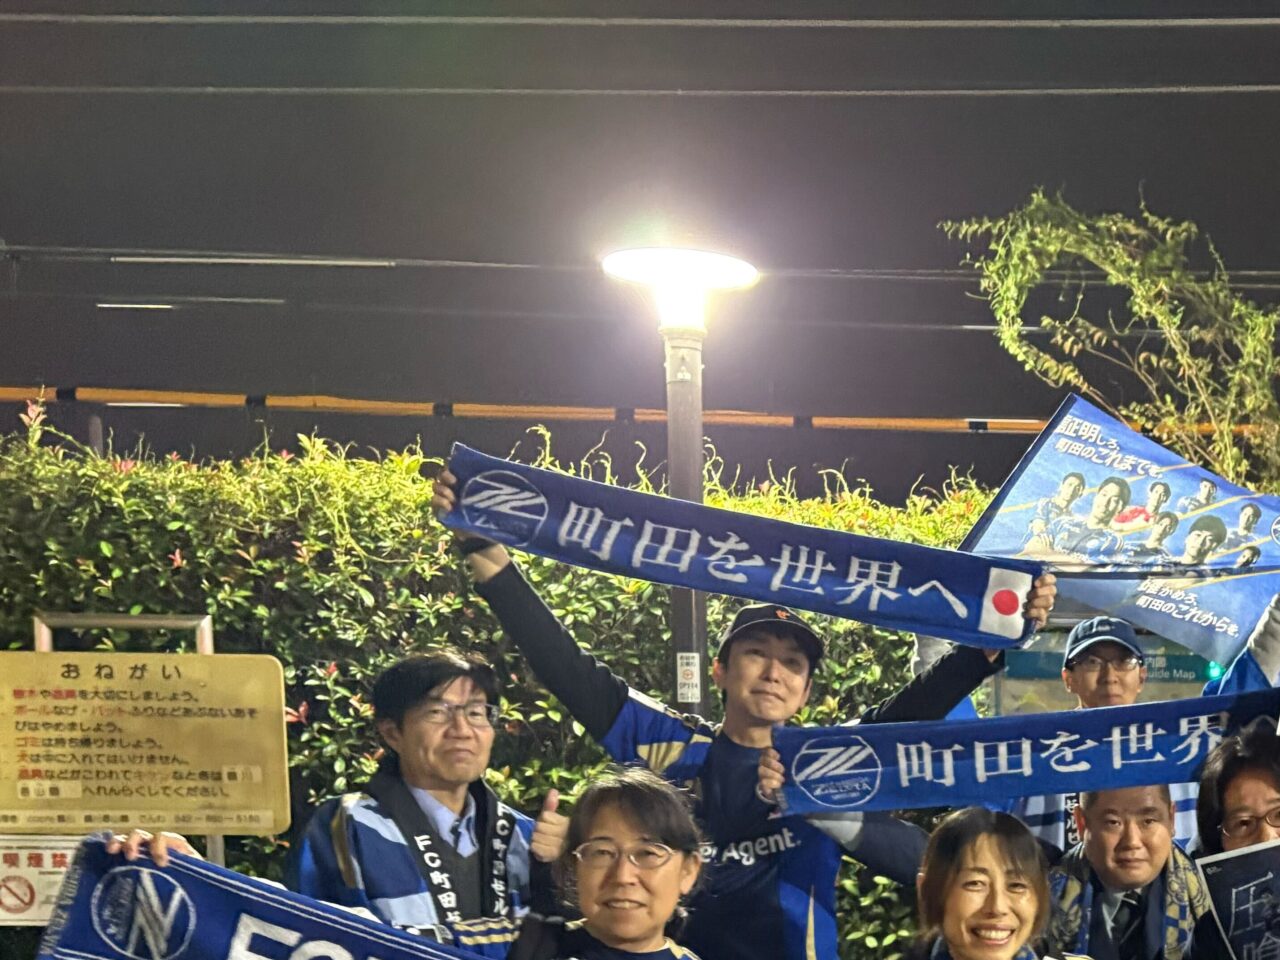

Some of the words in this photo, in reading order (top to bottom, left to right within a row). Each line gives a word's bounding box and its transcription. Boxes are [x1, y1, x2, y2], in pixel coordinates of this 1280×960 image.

[557, 499, 969, 620] 町田を世界へ
[61, 663, 182, 680] おねがい
[1173, 670, 1196, 680] Map
[896, 714, 1230, 788] 町田を世界
